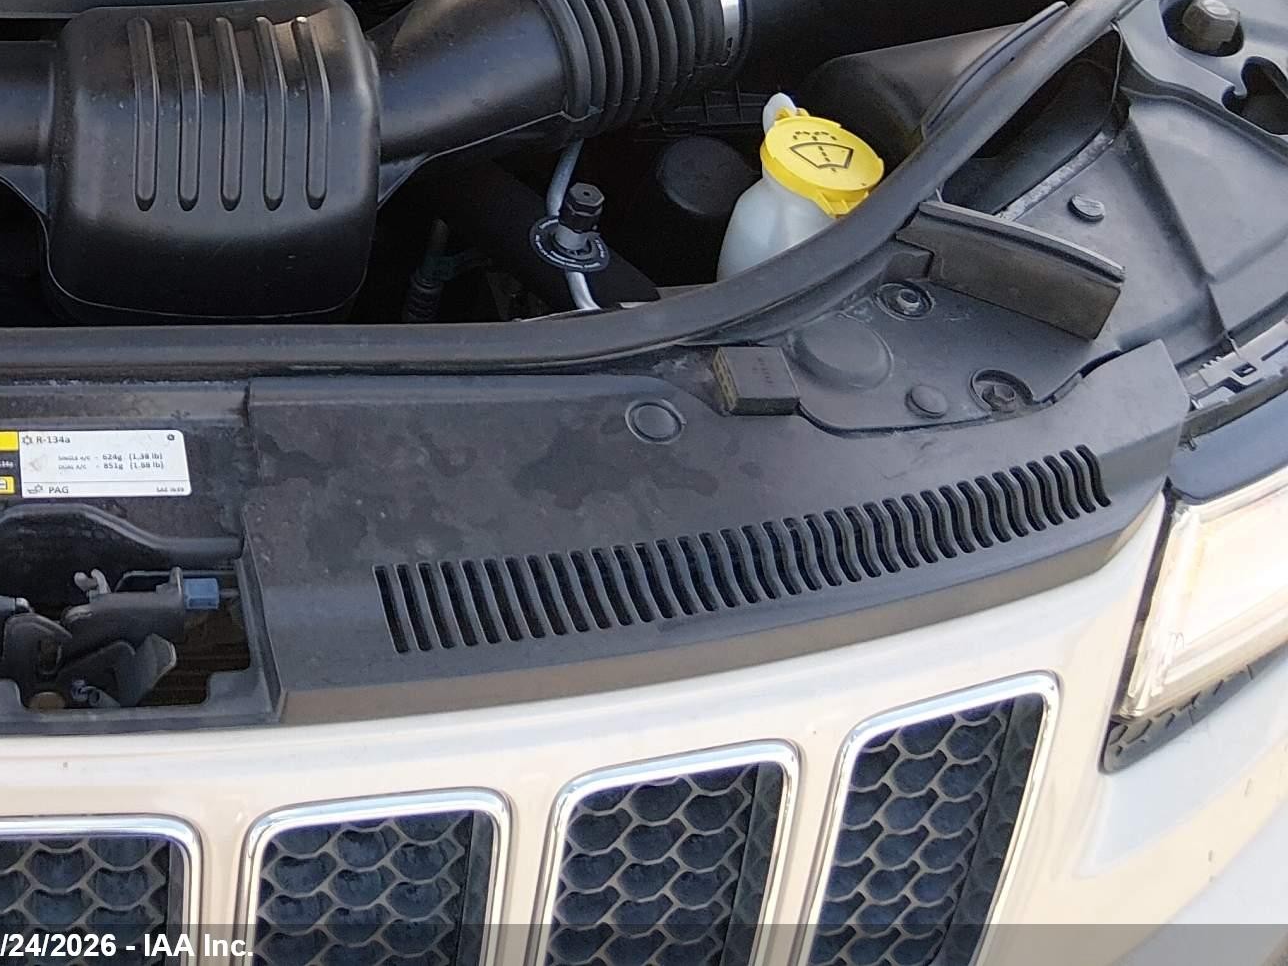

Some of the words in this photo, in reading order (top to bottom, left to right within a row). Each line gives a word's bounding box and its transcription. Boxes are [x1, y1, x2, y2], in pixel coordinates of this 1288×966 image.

[36, 435, 71, 444] R-134a
[102, 453, 123, 462] 624g
[103, 462, 124, 470] 851g
[48, 485, 69, 494] PAG
